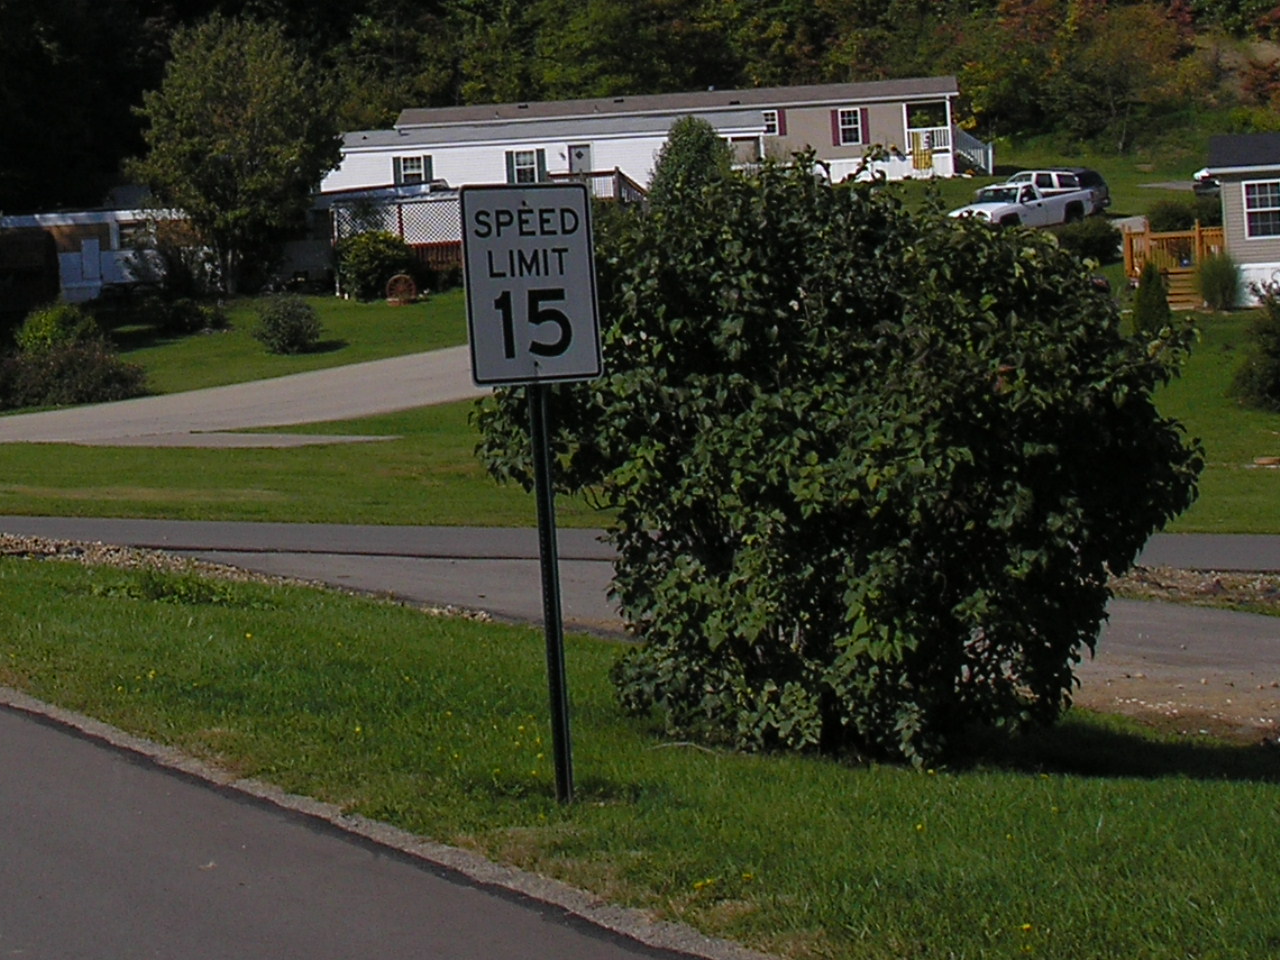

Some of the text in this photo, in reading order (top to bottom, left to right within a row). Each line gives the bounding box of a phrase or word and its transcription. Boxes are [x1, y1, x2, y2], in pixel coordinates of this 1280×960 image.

[474, 208, 579, 238] SPEED
[488, 248, 569, 278] LIMIT
[494, 288, 573, 359] 15
